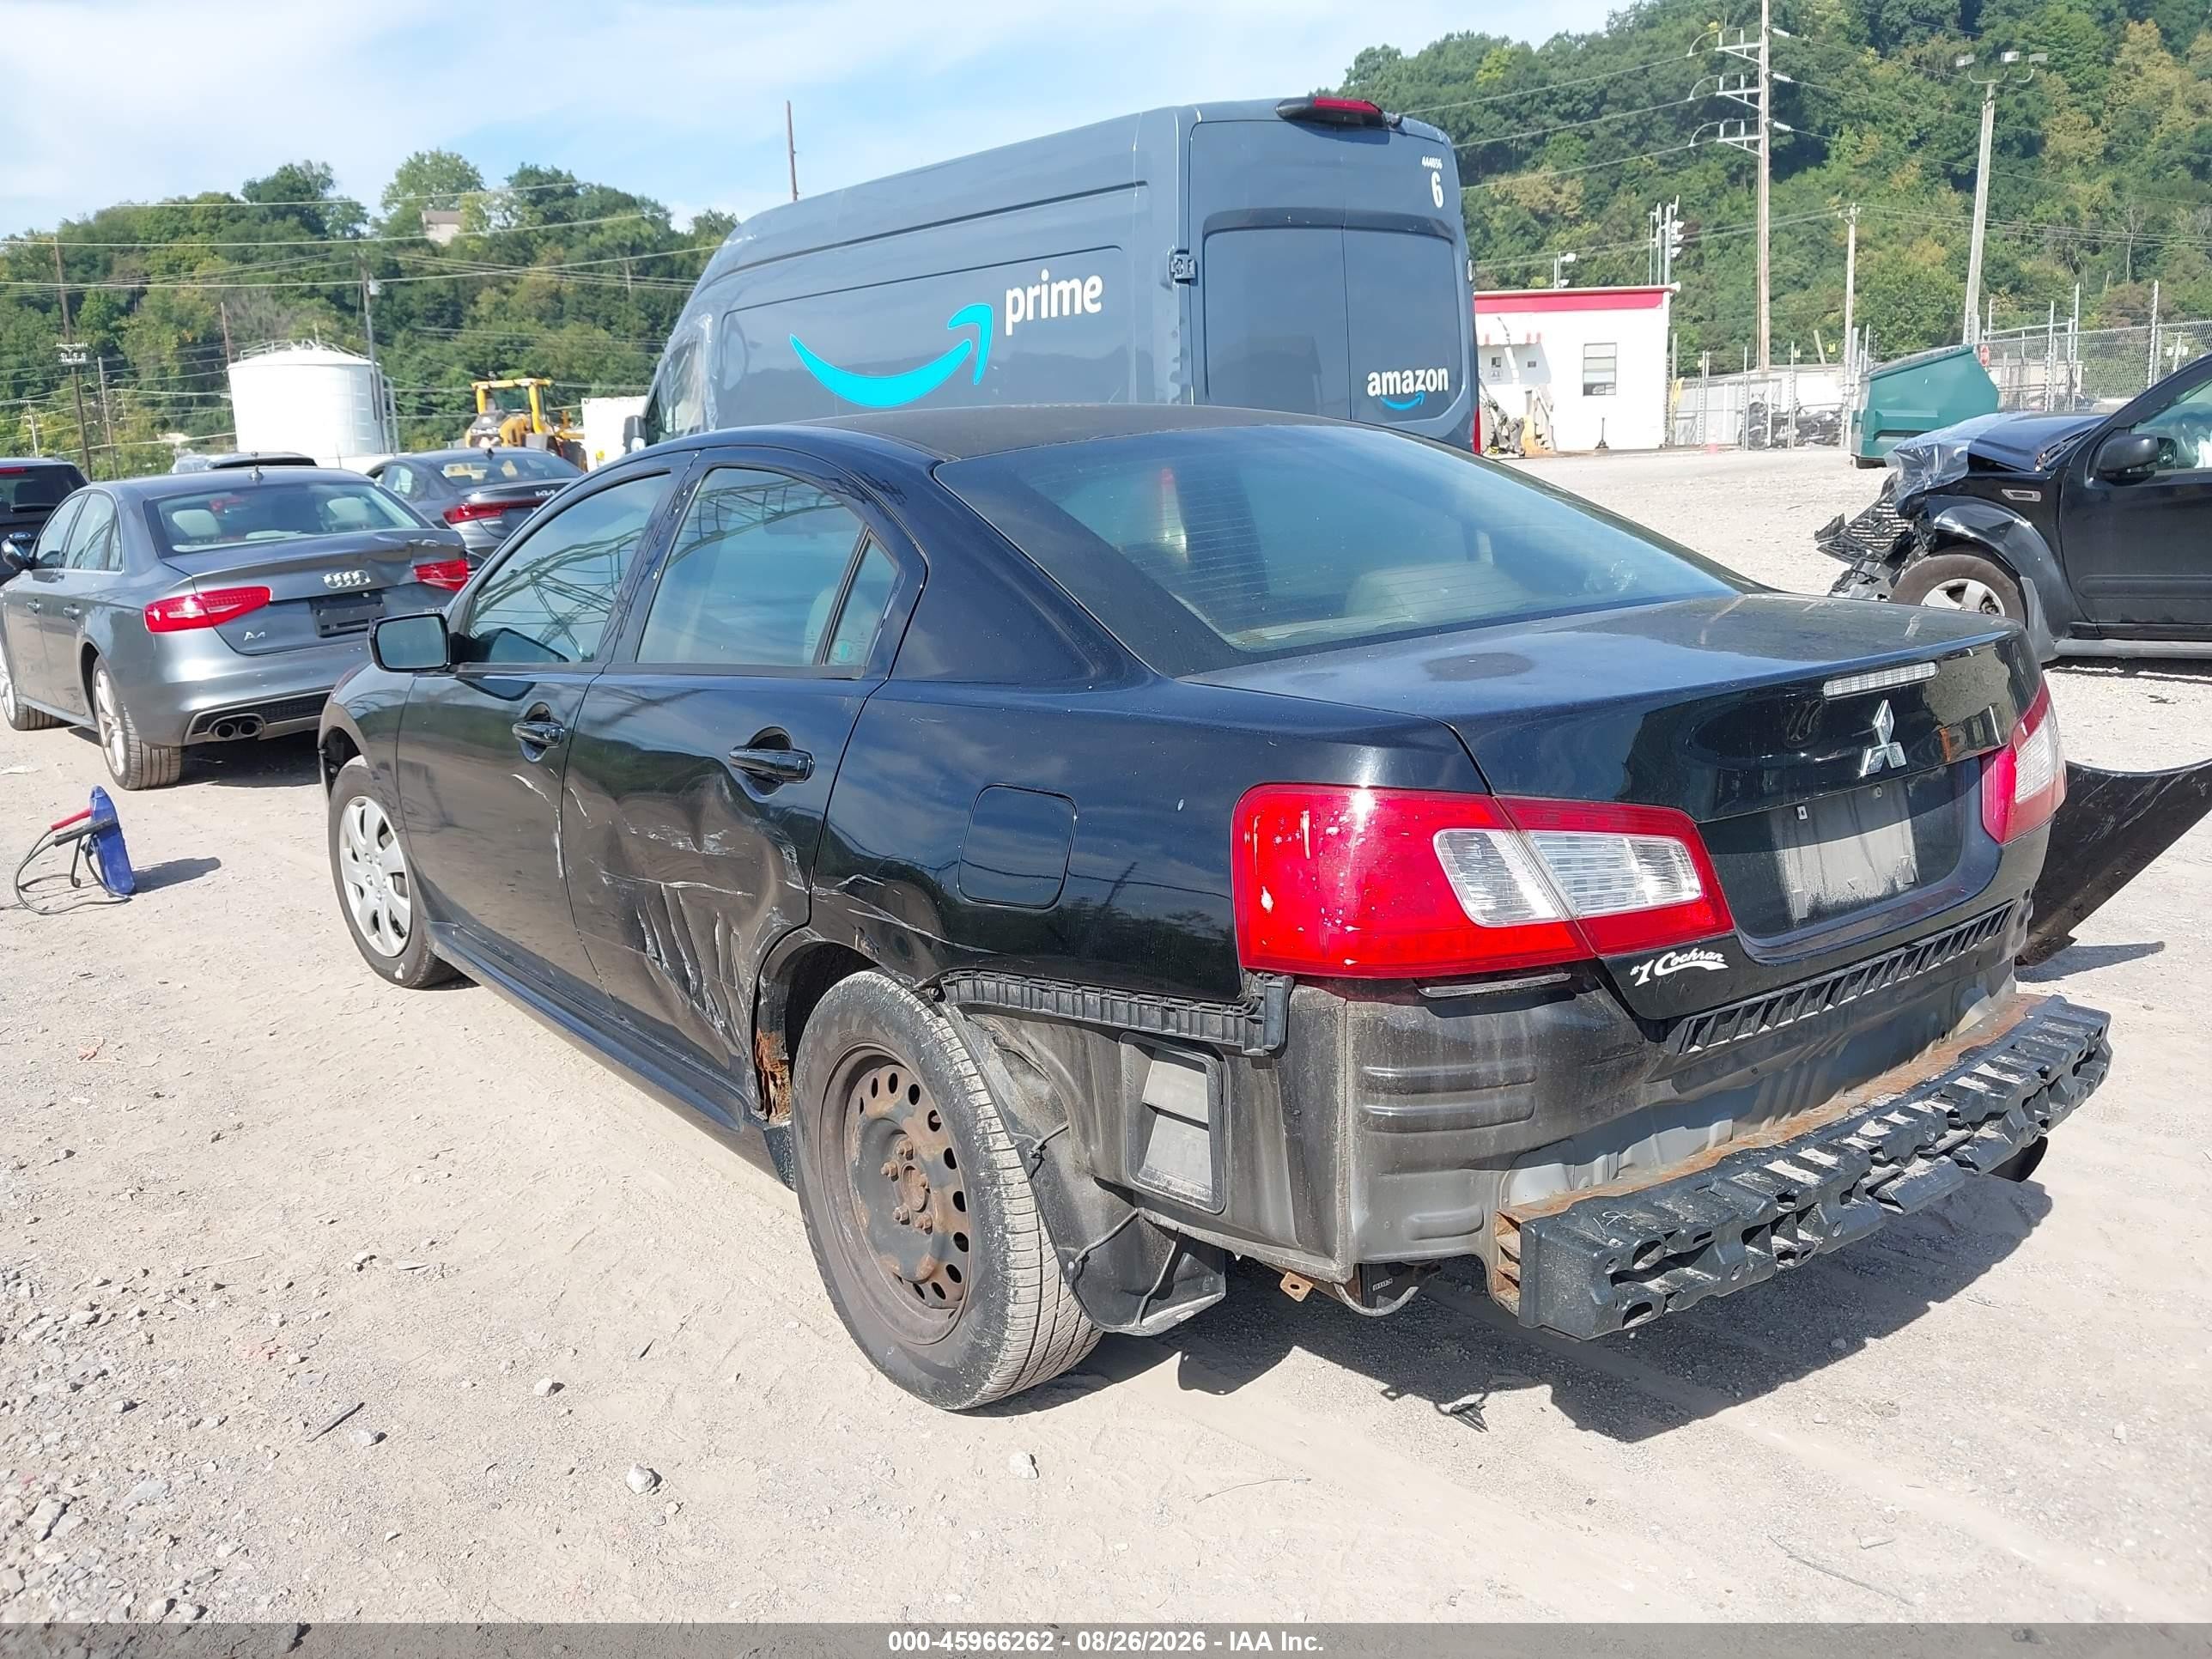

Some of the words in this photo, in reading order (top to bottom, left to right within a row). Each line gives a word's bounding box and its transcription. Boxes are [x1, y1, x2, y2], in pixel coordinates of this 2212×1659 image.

[1431, 171, 1444, 208] 6
[1006, 269, 1103, 336] prime
[1367, 368, 1449, 397] amazon
[1630, 959, 1655, 986] #1
[1654, 947, 1727, 975] Cochran
